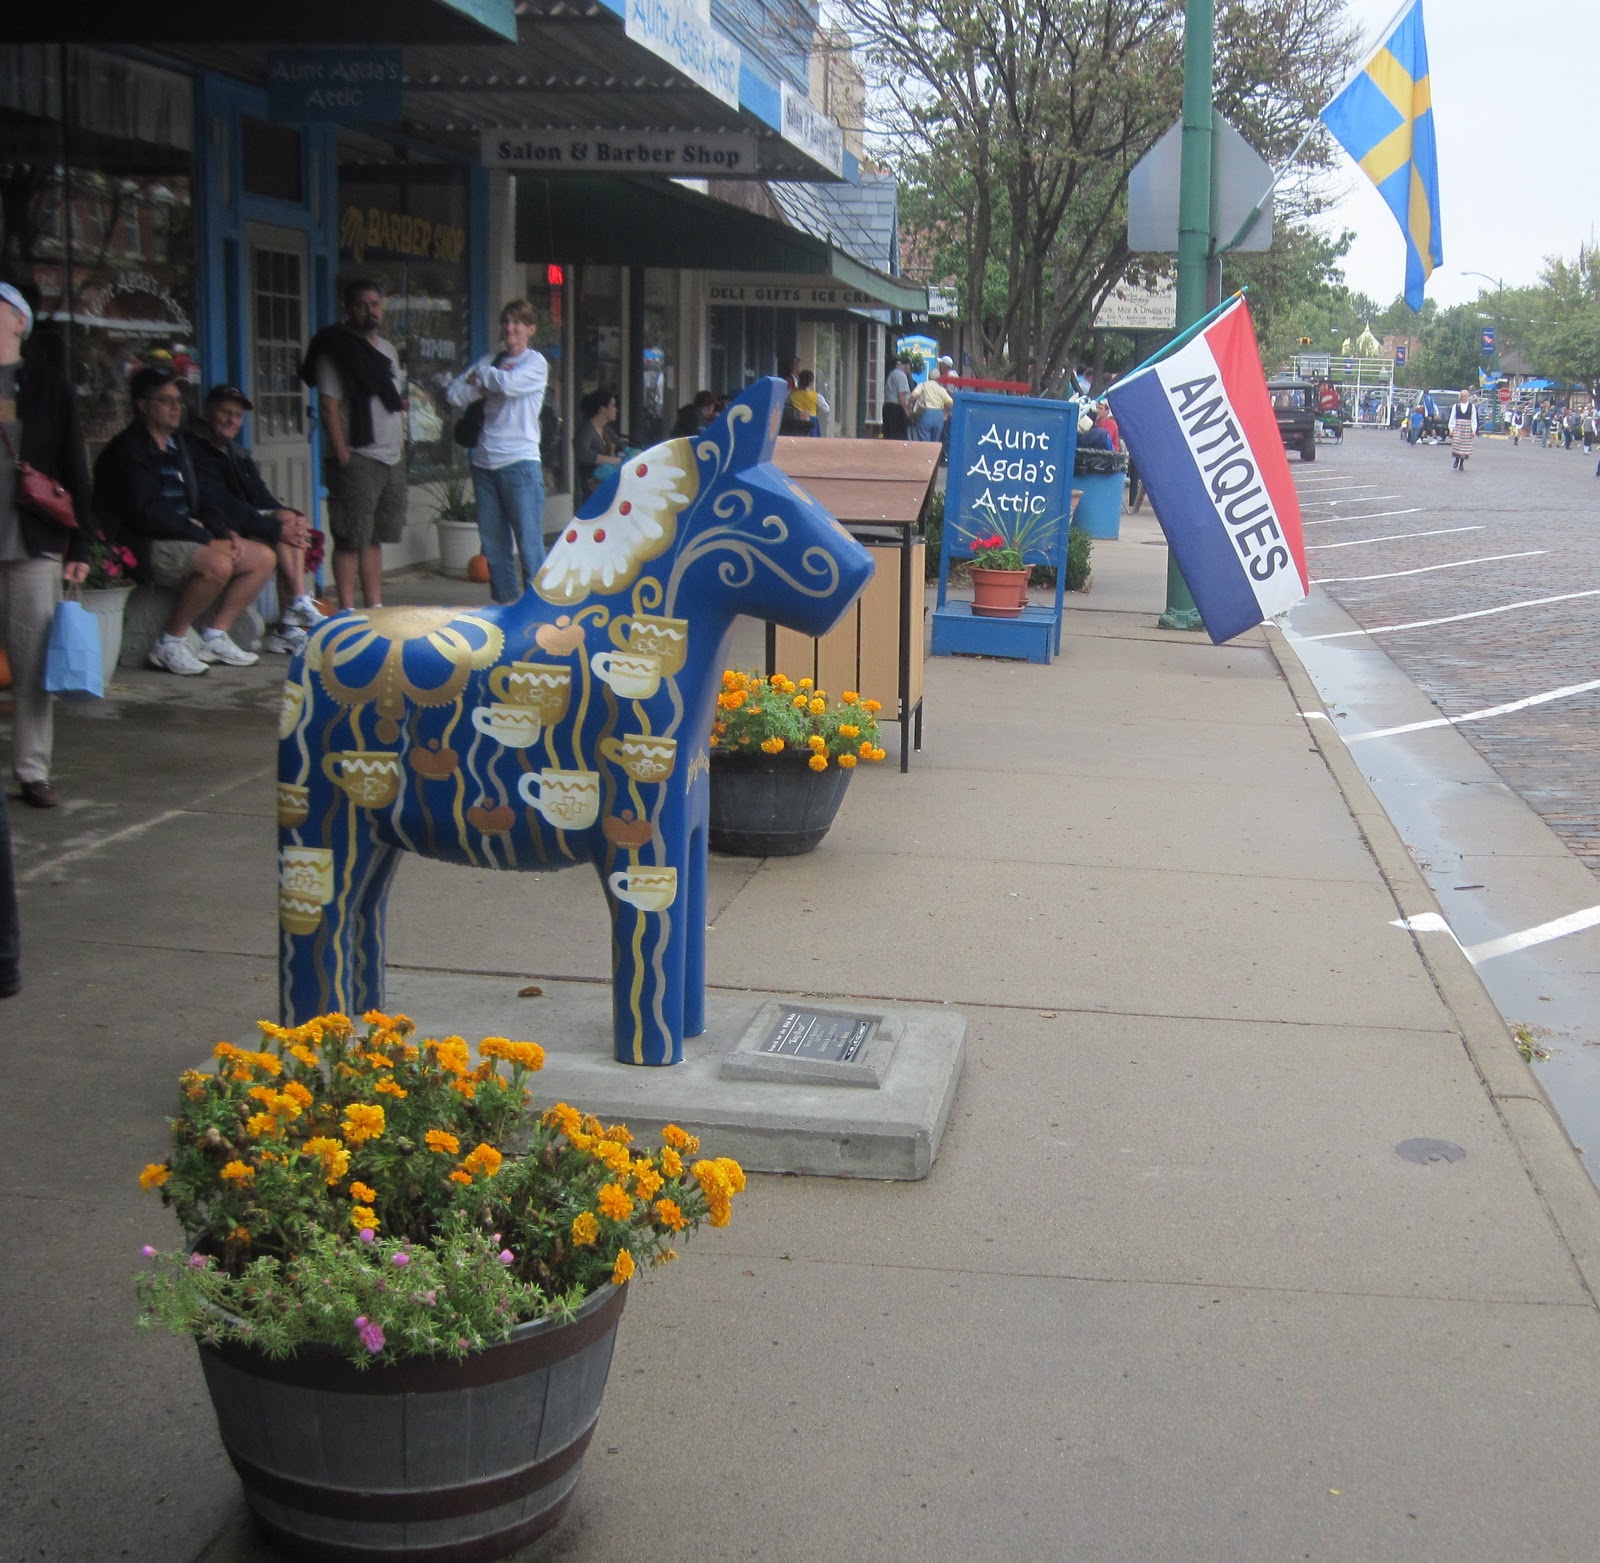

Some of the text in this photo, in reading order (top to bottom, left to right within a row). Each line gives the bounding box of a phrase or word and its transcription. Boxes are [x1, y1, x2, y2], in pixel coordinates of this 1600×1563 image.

[497, 142, 741, 168] Salon & Barber Shop
[366, 208, 431, 257] BARBER
[710, 287, 745, 300] DELI
[755, 288, 800, 301] GIFTS
[812, 290, 837, 302] ICE
[978, 423, 1050, 450] Aunt
[966, 454, 1056, 483] Agda's
[1170, 373, 1289, 582] ANTIQUES
[971, 487, 1046, 514] Attic
